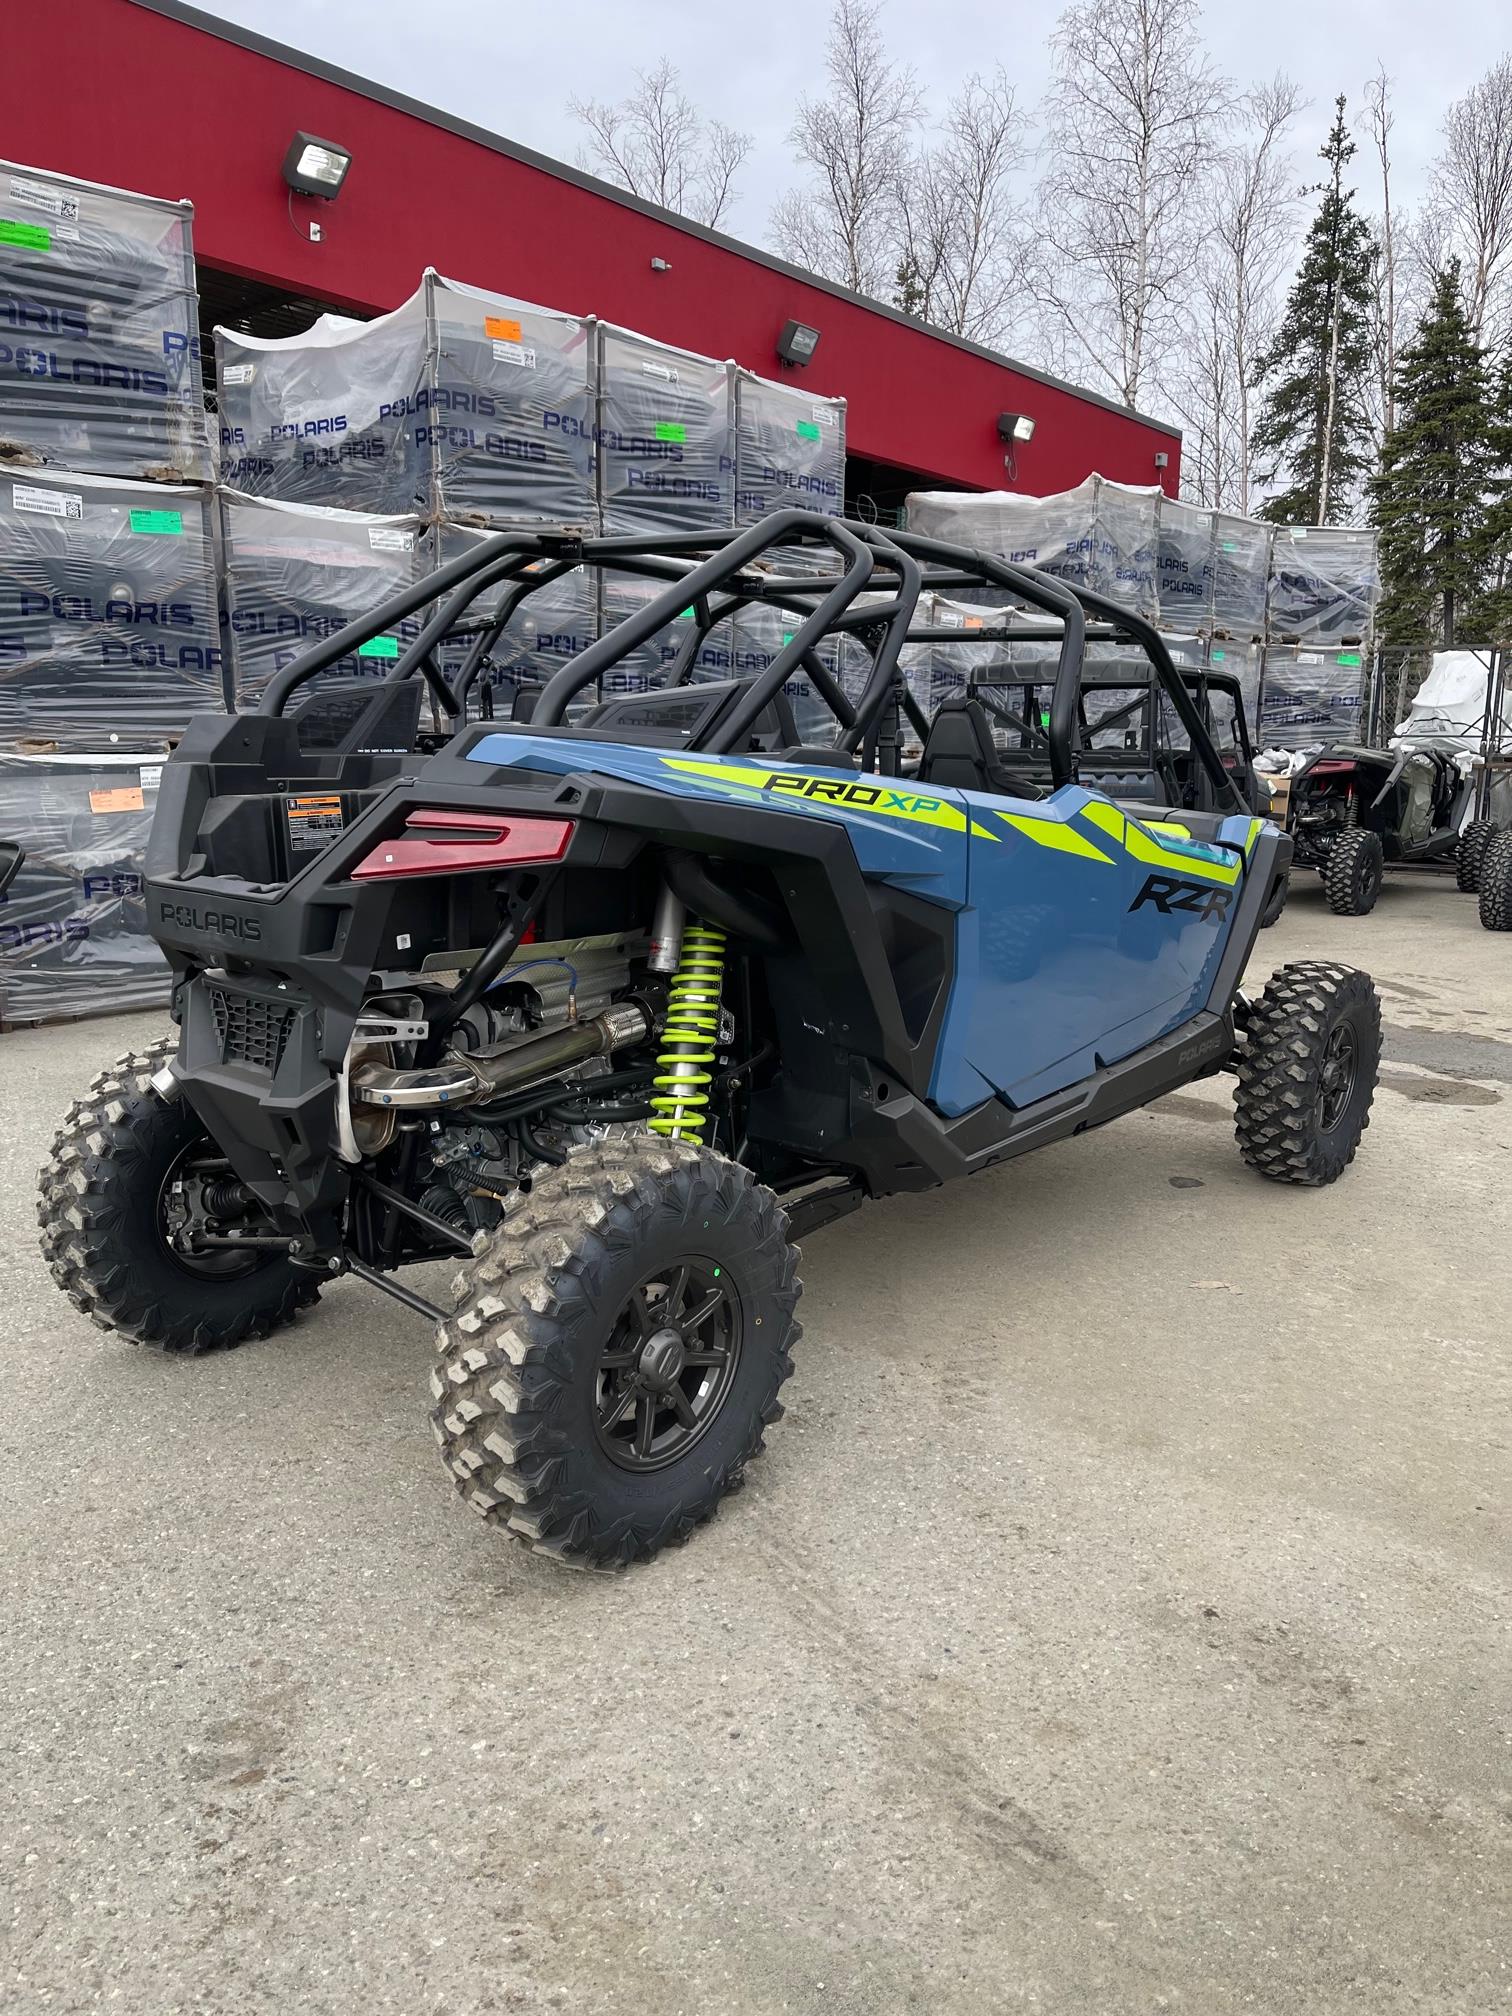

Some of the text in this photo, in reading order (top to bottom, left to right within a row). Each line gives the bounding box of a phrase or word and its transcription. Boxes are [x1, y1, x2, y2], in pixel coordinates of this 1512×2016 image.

[219, 427, 245, 445] RIS
[271, 415, 347, 442] POLARIS
[627, 468, 720, 502] POLARIS
[764, 466, 837, 496] POLARIS
[1162, 578, 1203, 596] POLARIS
[21, 591, 194, 626] POLARIS
[763, 774, 942, 813] PRO XP
[1127, 873, 1234, 923] RZR
[160, 902, 262, 941] POLARIS
